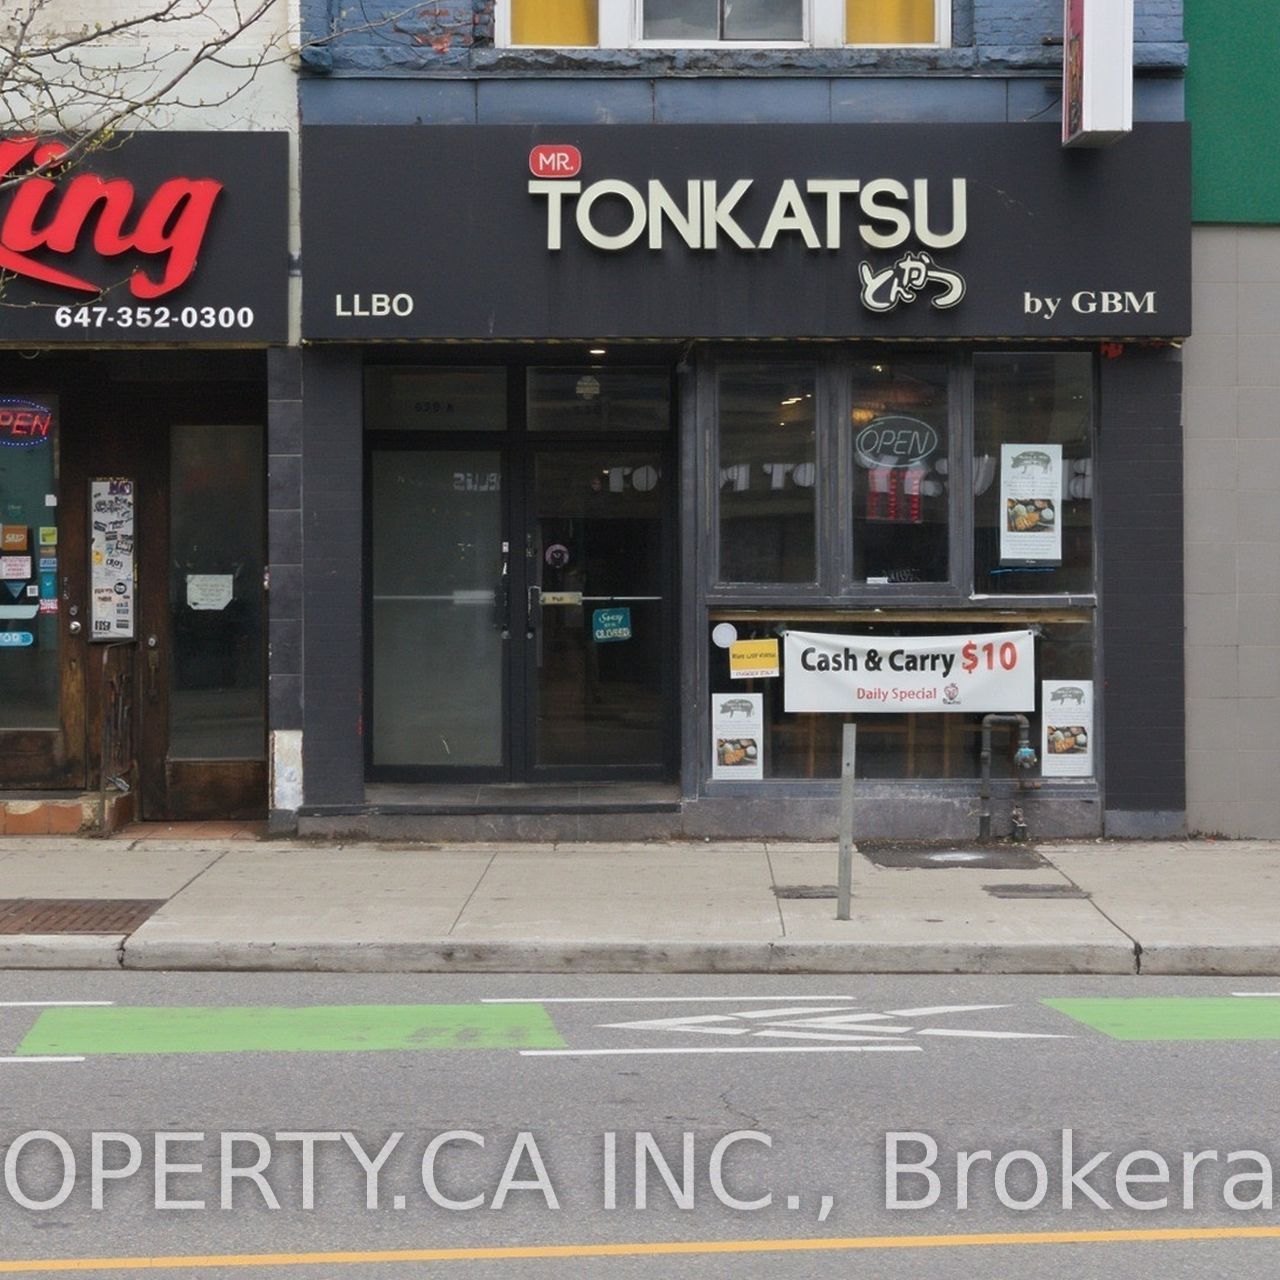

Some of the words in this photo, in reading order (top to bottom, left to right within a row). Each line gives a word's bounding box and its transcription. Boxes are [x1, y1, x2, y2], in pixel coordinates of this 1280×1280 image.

[538, 152, 575, 171] MR.
[528, 177, 968, 251] TONKATSU
[859, 252, 966, 312] とんかつ
[54, 306, 255, 329] 647-352-0300
[335, 293, 414, 317] LLBO
[1023, 291, 1061, 320] by
[1071, 290, 1157, 314] GBM
[860, 428, 930, 456] OPEN
[801, 646, 858, 672] Cash
[864, 648, 883, 672] &
[888, 648, 956, 678] Carry
[961, 640, 1018, 674] $10
[856, 687, 889, 703] Daily
[892, 687, 938, 703] Special
